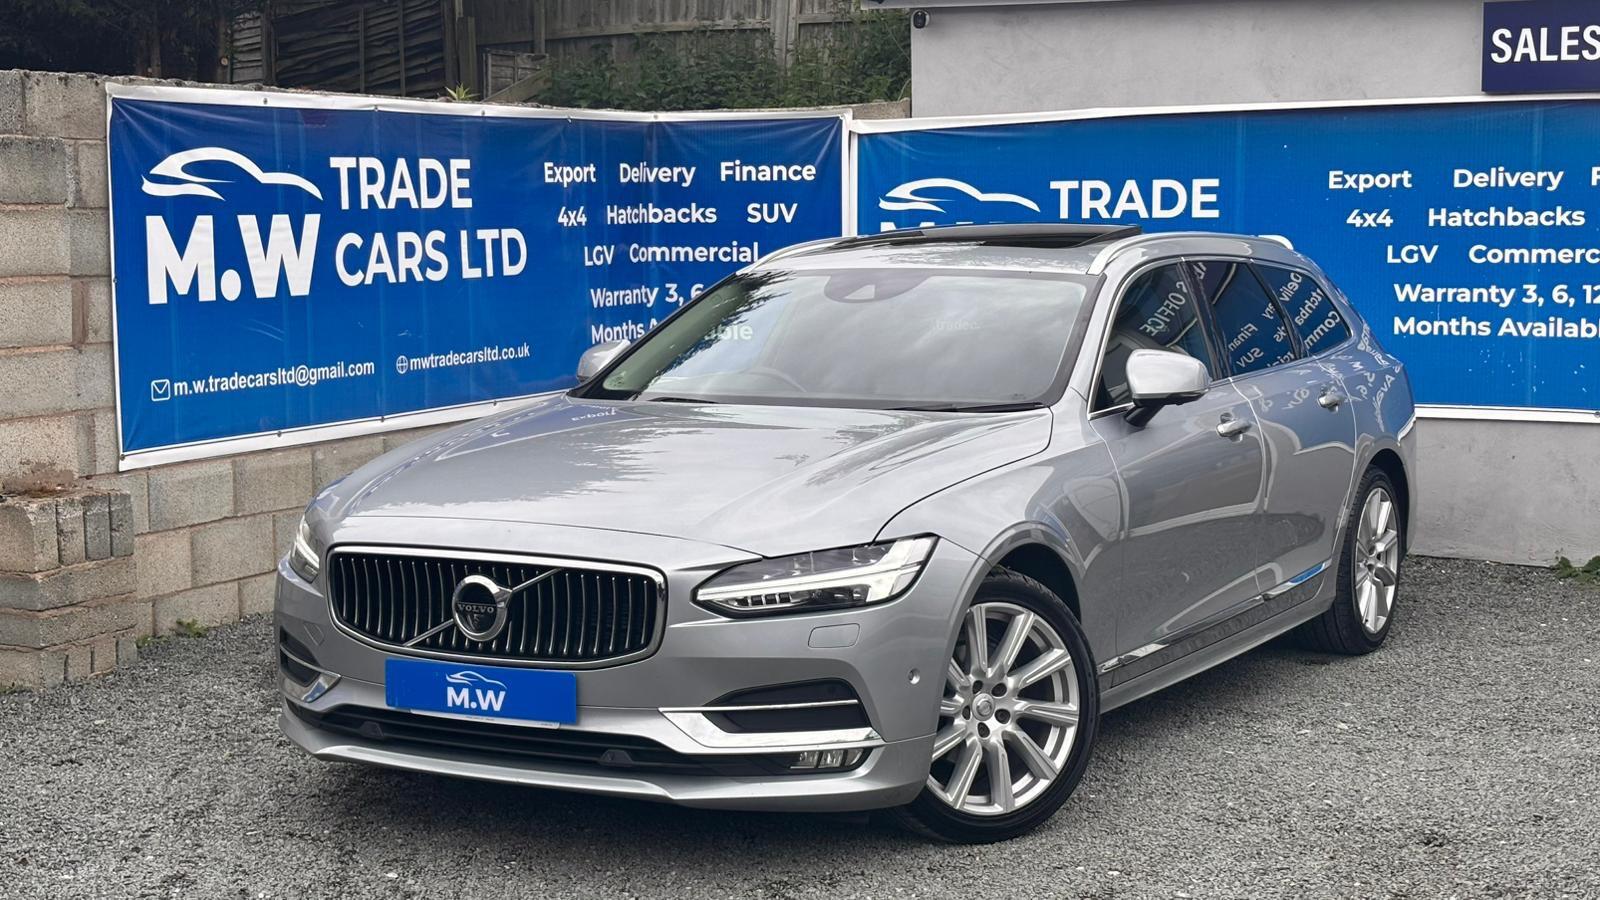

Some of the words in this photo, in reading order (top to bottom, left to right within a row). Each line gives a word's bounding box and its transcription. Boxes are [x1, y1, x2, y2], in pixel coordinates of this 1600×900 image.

[1491, 25, 1600, 63] SALES
[330, 157, 472, 209] TRADE
[544, 162, 596, 187] Export
[620, 162, 696, 187] Delivery
[721, 160, 816, 181] Finance
[1329, 171, 1412, 192] Export
[1454, 167, 1563, 191] Delivery
[1050, 179, 1219, 218] TRADE
[558, 206, 587, 226] 4x4
[607, 203, 717, 224] Hatchbacks
[748, 203, 797, 223] SUV
[1347, 209, 1393, 227] 4x4
[1429, 206, 1585, 226] Hatchbacks
[146, 214, 320, 304] M.W
[336, 230, 448, 286] CARS
[461, 229, 527, 278] LTD
[585, 245, 614, 266] LGV
[630, 241, 758, 263] Commercial
[1388, 245, 1438, 263] LGV
[1469, 245, 1600, 263] Commerc
[591, 286, 658, 307] Warranty
[665, 284, 684, 306] 3,
[1394, 284, 1515, 307] Warranty
[1522, 285, 1544, 306] 3,
[1552, 285, 1575, 307] 6,
[1583, 285, 1600, 303] 12
[591, 320, 645, 344] Months
[1394, 317, 1491, 336] Months
[1498, 317, 1600, 338] Availab
[410, 343, 529, 370] mwtradecarsltd.co.uk
[174, 362, 374, 395] m.w.tradecarsltd@gmail.com
[457, 603, 495, 613] VOLVO
[446, 687, 506, 711] M.W
